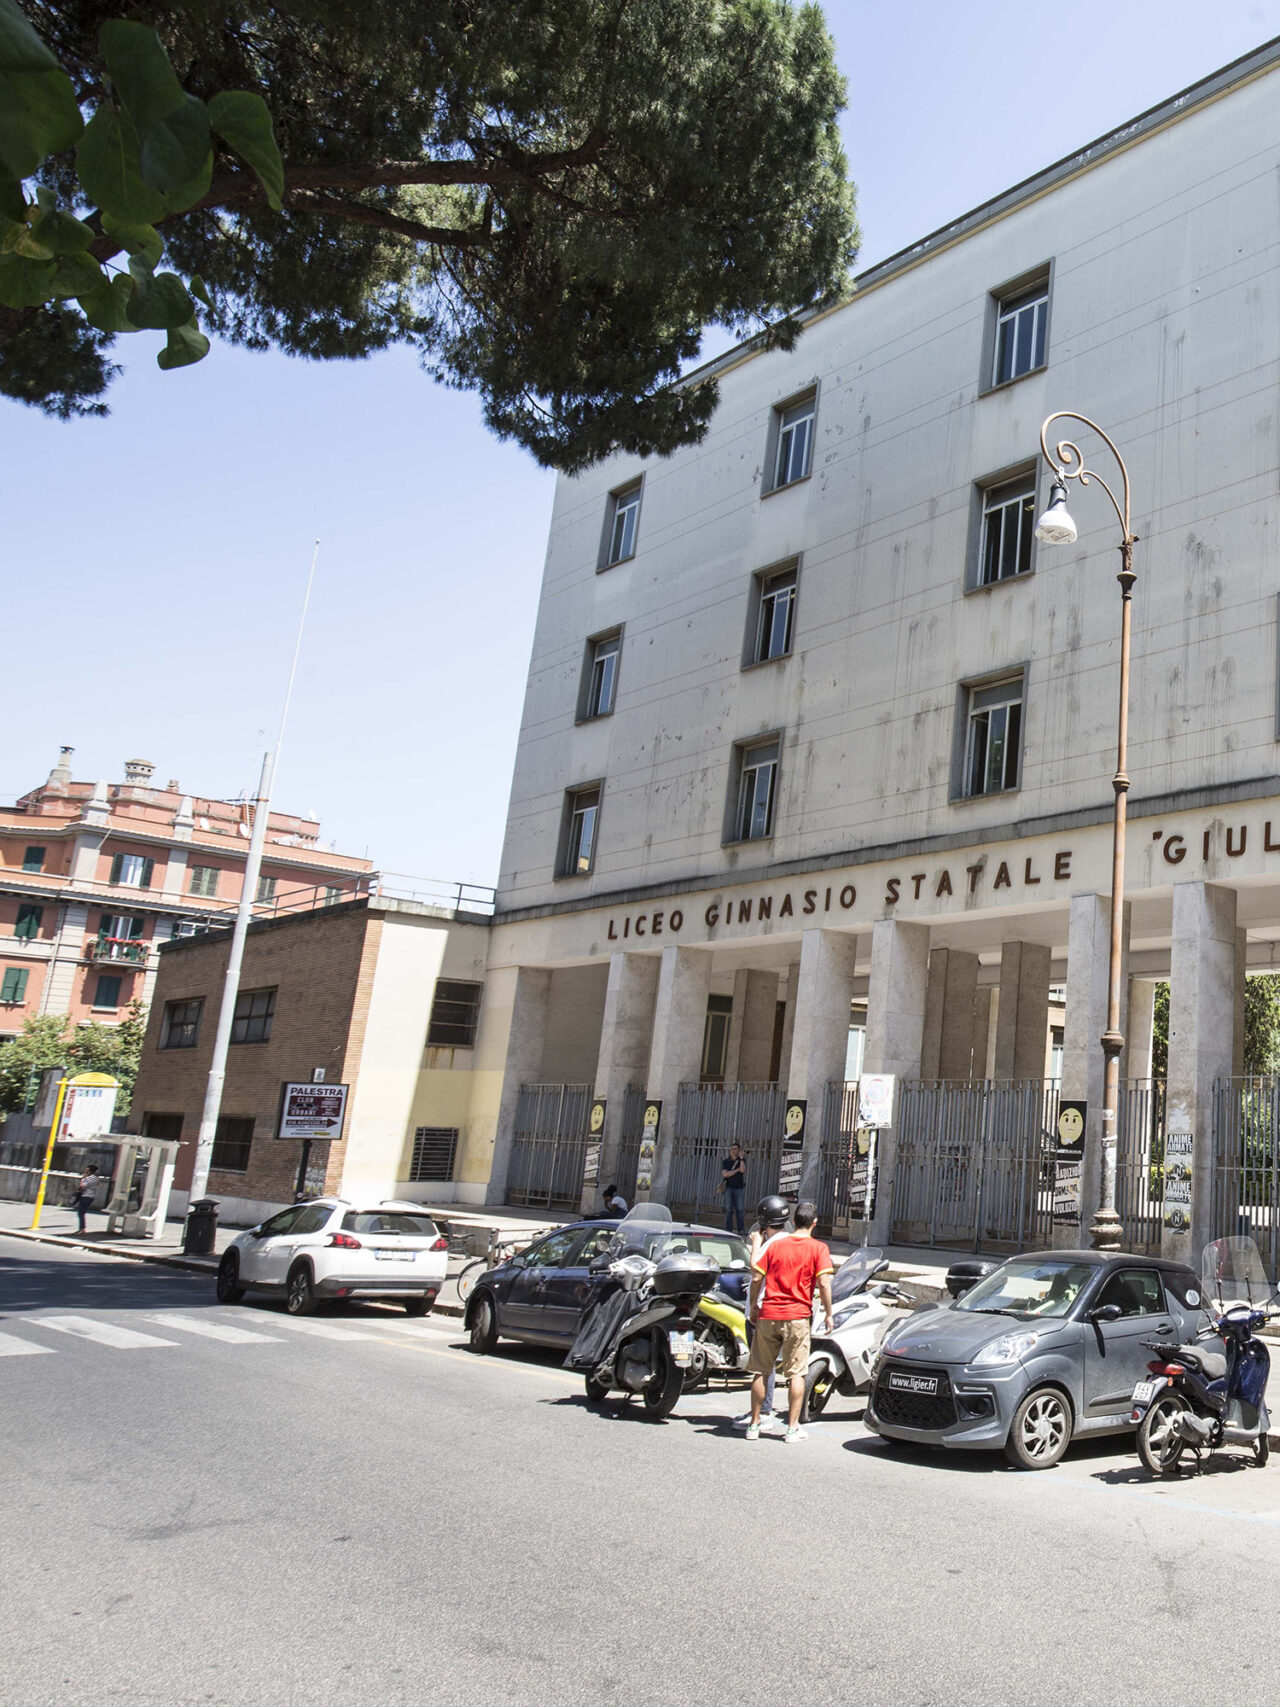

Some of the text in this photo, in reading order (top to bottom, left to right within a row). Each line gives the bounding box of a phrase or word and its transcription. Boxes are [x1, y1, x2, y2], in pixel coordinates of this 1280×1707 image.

[608, 910, 683, 940] LICEO
[705, 885, 857, 927] GINNASIO
[885, 851, 1072, 904] STATALE
[290, 1087, 343, 1096] PALESTRA
[1168, 1135, 1191, 1144] ANIME
[1166, 1181, 1191, 1191] ANIME
[892, 1376, 935, 1392] www.ligier.fr
